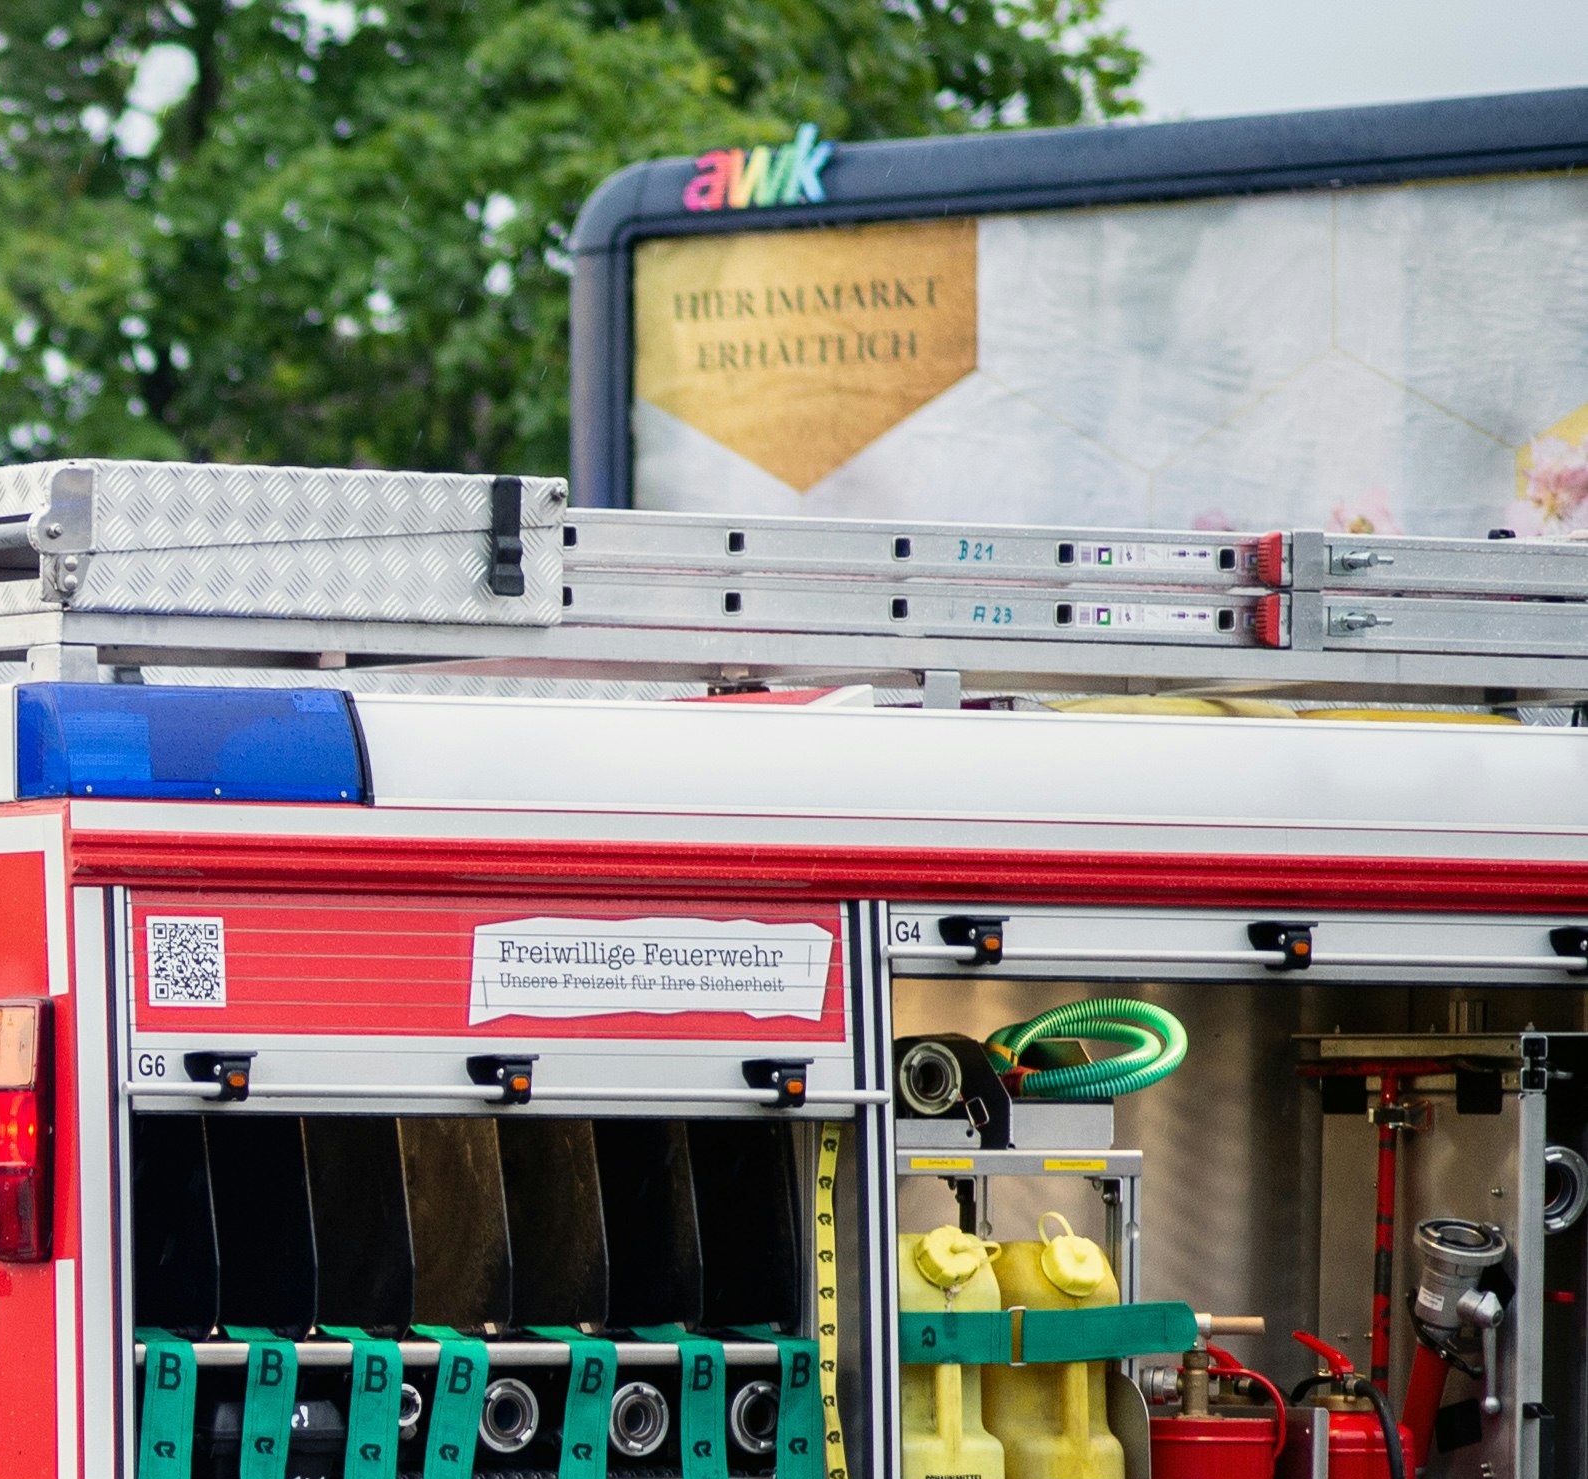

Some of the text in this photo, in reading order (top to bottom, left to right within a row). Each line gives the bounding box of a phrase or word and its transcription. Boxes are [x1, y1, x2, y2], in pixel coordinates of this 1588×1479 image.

[683, 122, 835, 212] awk
[674, 277, 940, 321] HIER IM MARKT
[895, 921, 921, 944] G4
[498, 940, 783, 970] Freiwillige Feuerwehr
[499, 972, 785, 993] Unsere Freizeit für Ihre Sicherheit
[138, 1054, 166, 1078] G6
[157, 1352, 182, 1391] B
[259, 1349, 283, 1387] B
[364, 1355, 388, 1393] B
[448, 1356, 474, 1395] B
[578, 1357, 604, 1395] B
[689, 1354, 714, 1392] B
[789, 1351, 813, 1389] B
